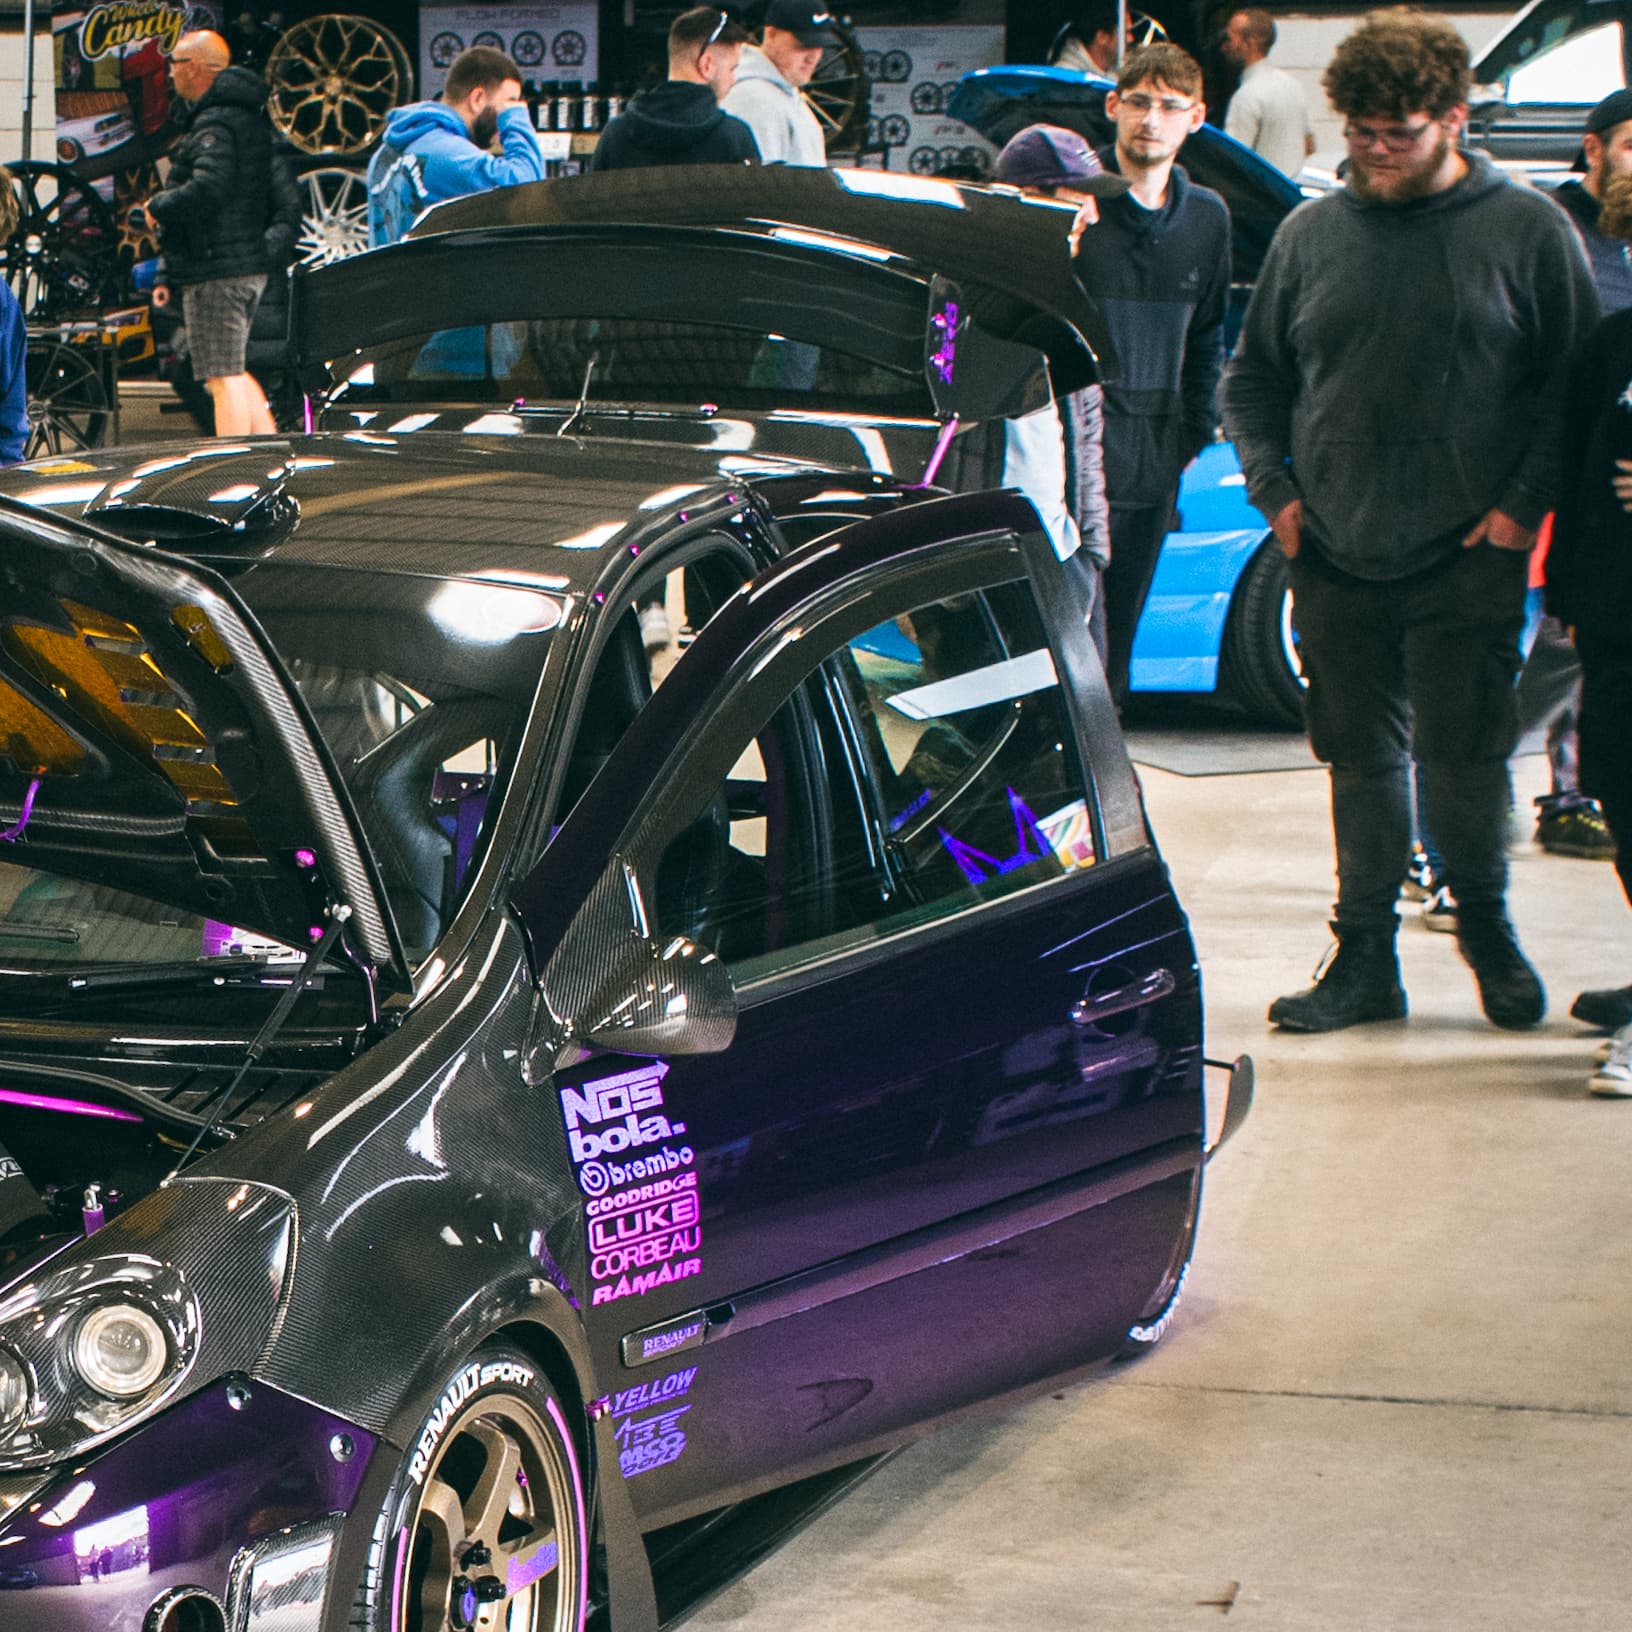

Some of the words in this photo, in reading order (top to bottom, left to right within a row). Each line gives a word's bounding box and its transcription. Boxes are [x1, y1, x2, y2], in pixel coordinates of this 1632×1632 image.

[84, 6, 183, 56] Candy
[560, 1062, 669, 1129] NOS
[608, 1146, 695, 1186] brembo
[585, 1171, 698, 1217] GOODRIDGE
[594, 1197, 696, 1246] LUKE
[590, 1226, 702, 1280] CORBEAU
[591, 1258, 702, 1306] RAMAIR
[642, 1322, 701, 1352] RENAULT
[612, 1366, 699, 1412] YELLOW
[408, 1362, 481, 1486] RENAULT
[479, 1362, 535, 1388] SPORT
